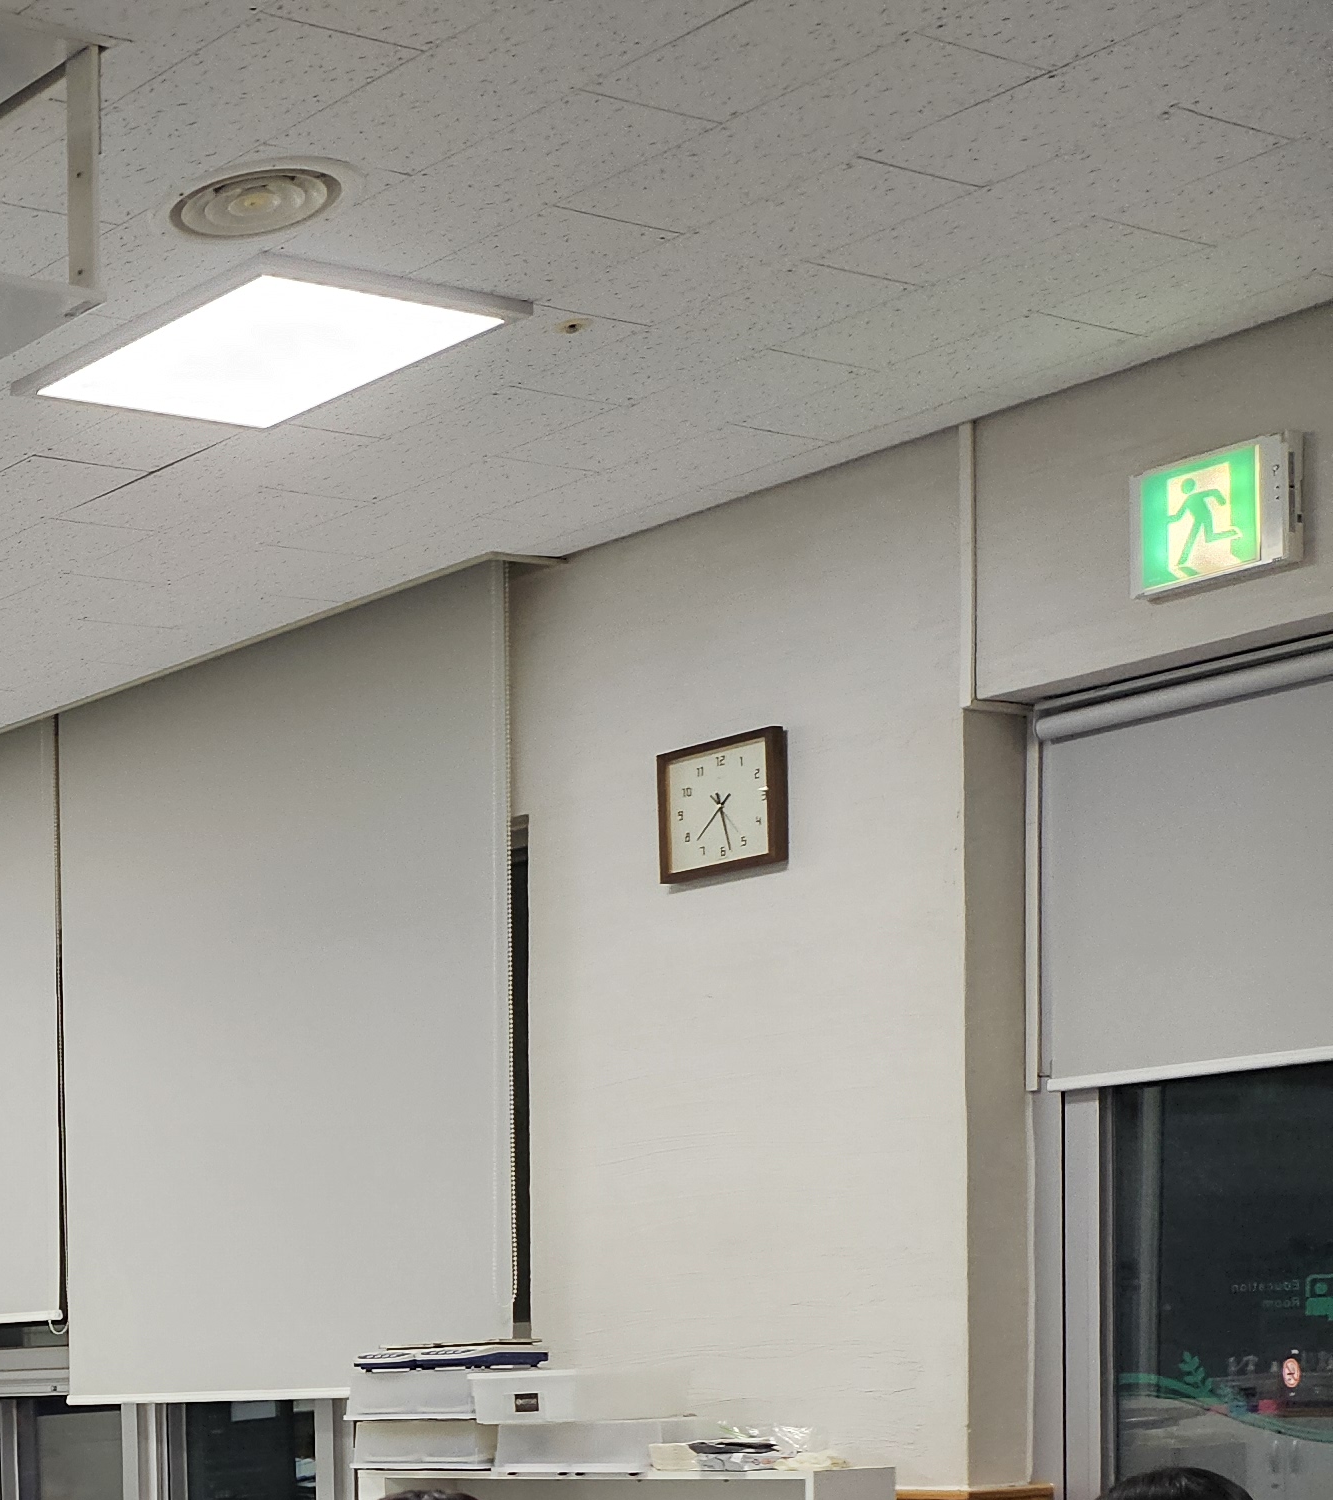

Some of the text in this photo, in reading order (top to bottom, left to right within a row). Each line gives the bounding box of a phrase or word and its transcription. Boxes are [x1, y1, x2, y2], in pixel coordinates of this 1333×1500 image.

[715, 755, 726, 767] 12
[696, 766, 704, 777] 11
[754, 768, 760, 779] 2
[681, 787, 693, 797] 10
[677, 810, 684, 821] 9
[740, 836, 747, 847] 5
[699, 845, 706, 856] 7
[720, 846, 727, 857] 6
